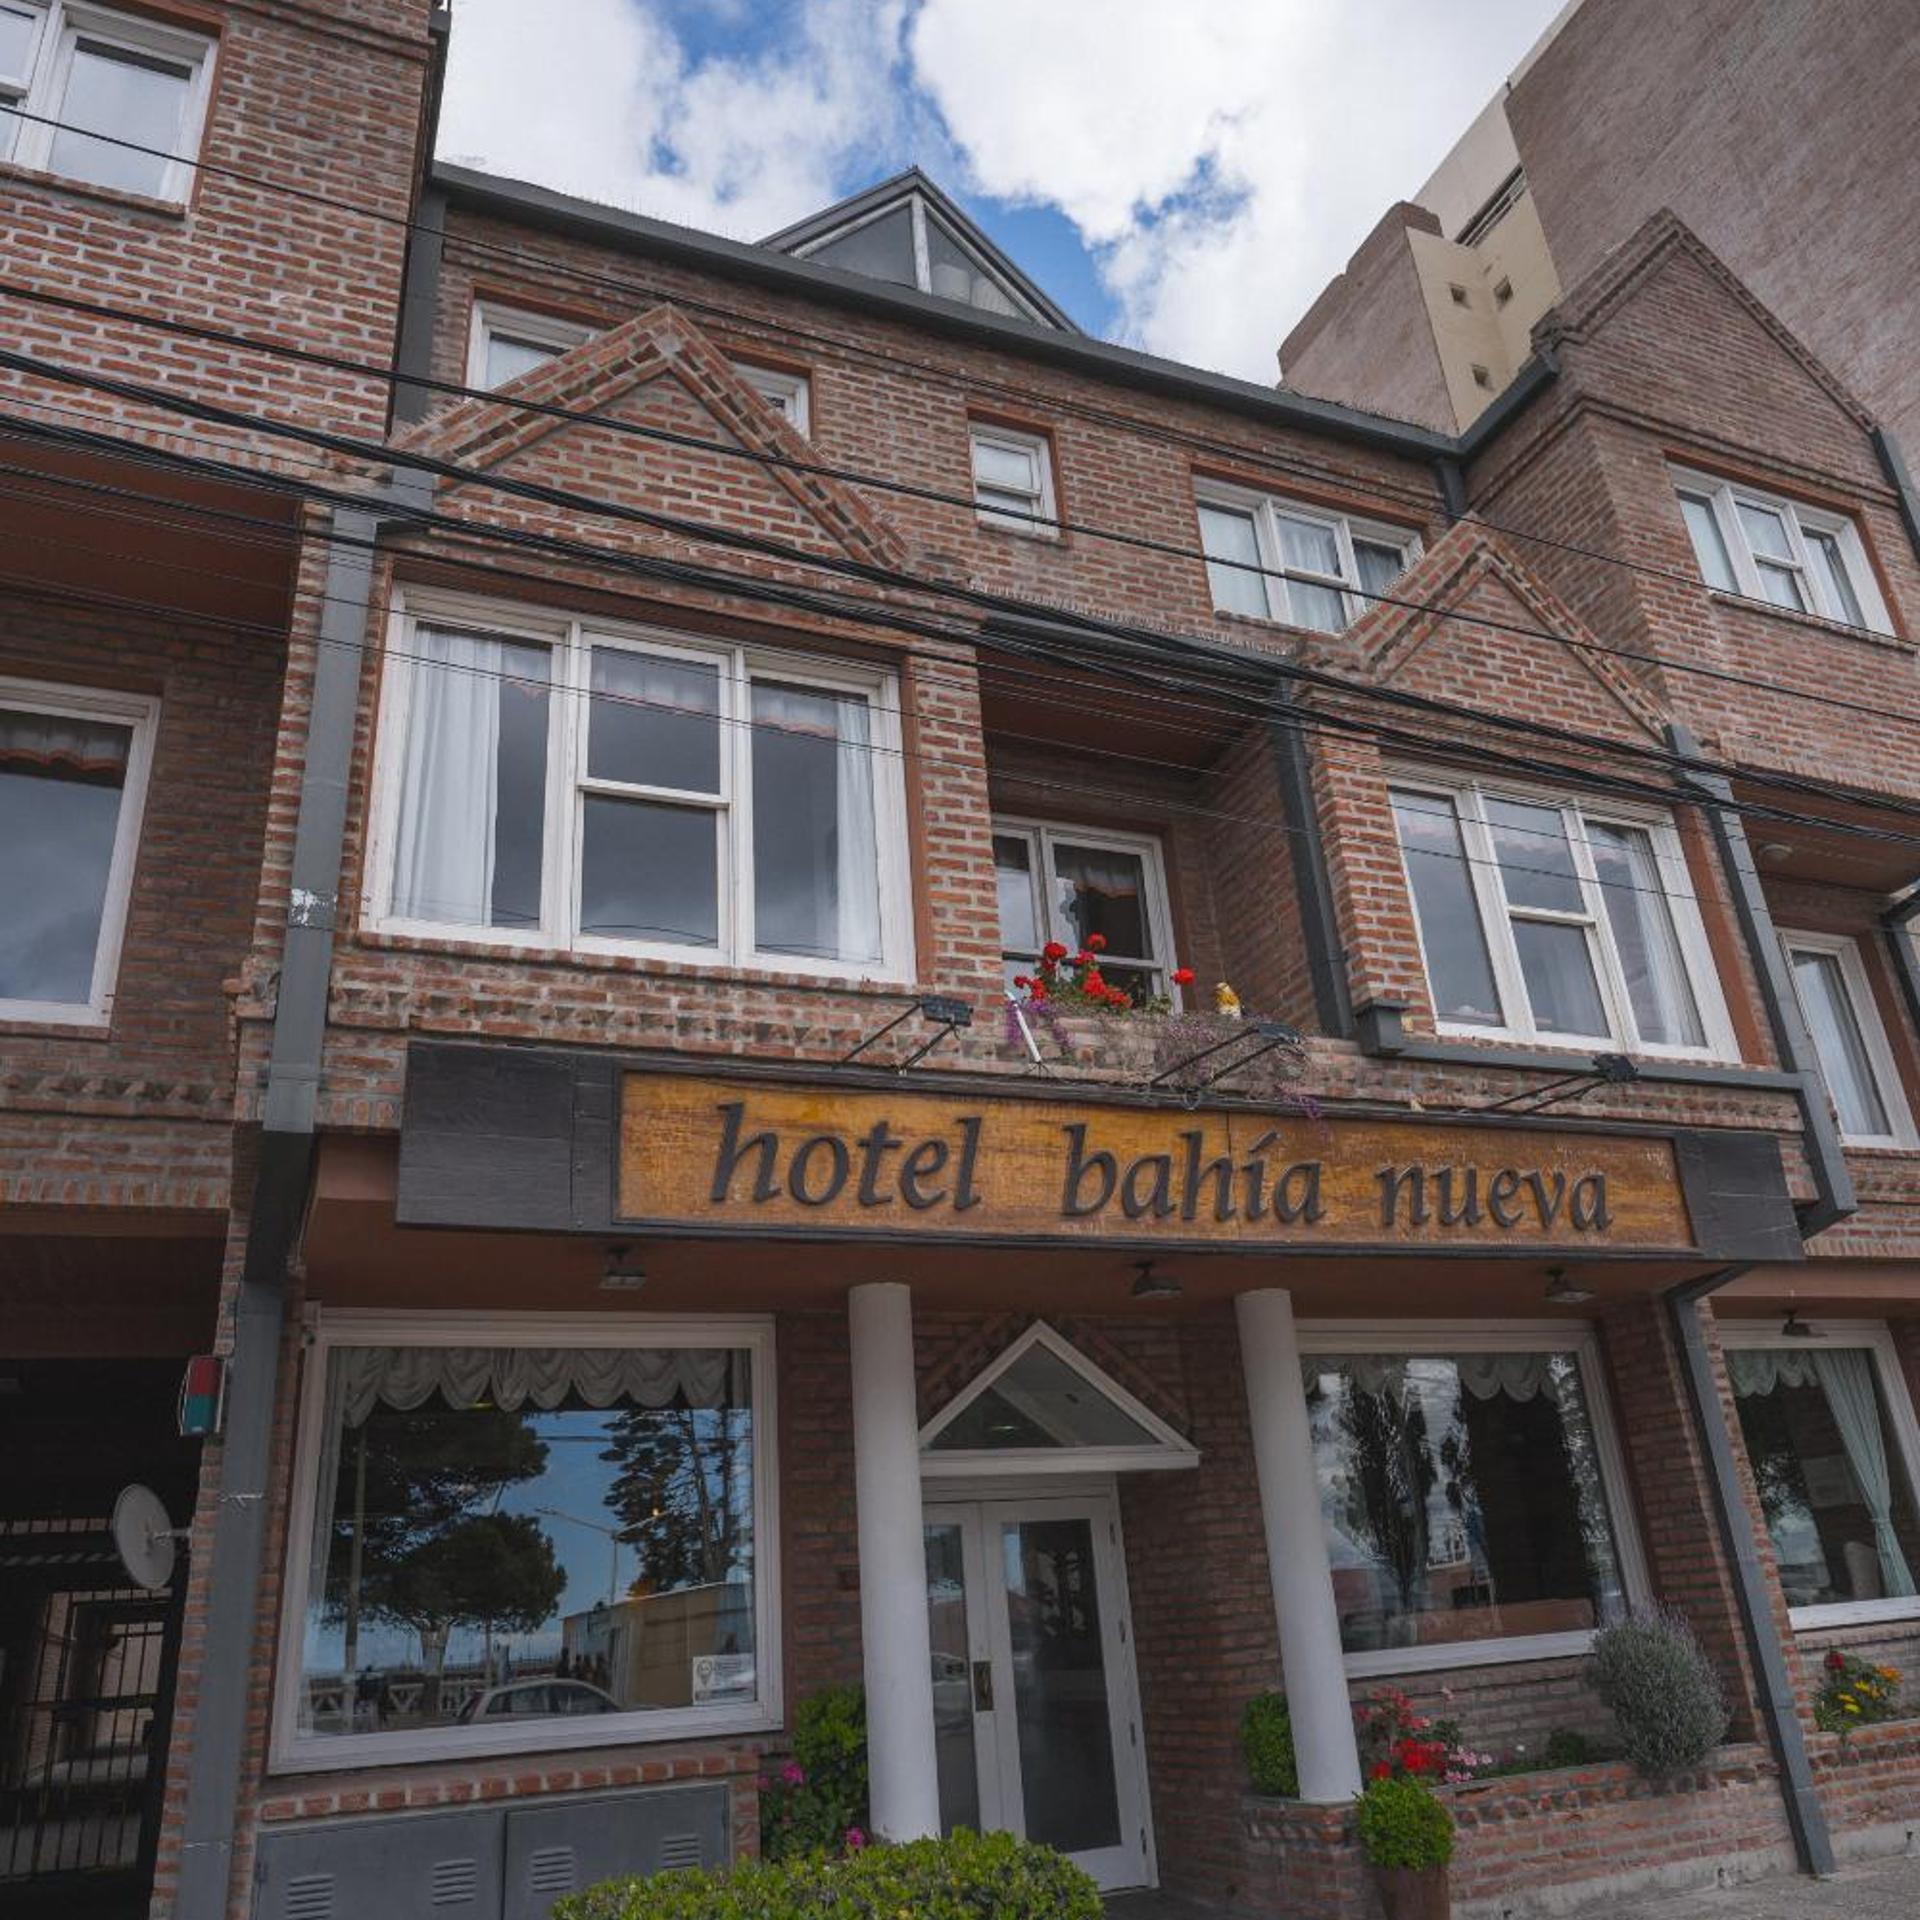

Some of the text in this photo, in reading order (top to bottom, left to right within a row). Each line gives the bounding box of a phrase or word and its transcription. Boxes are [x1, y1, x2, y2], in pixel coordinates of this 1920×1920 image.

[710, 1101, 1614, 1231] hotel bahía nueva
